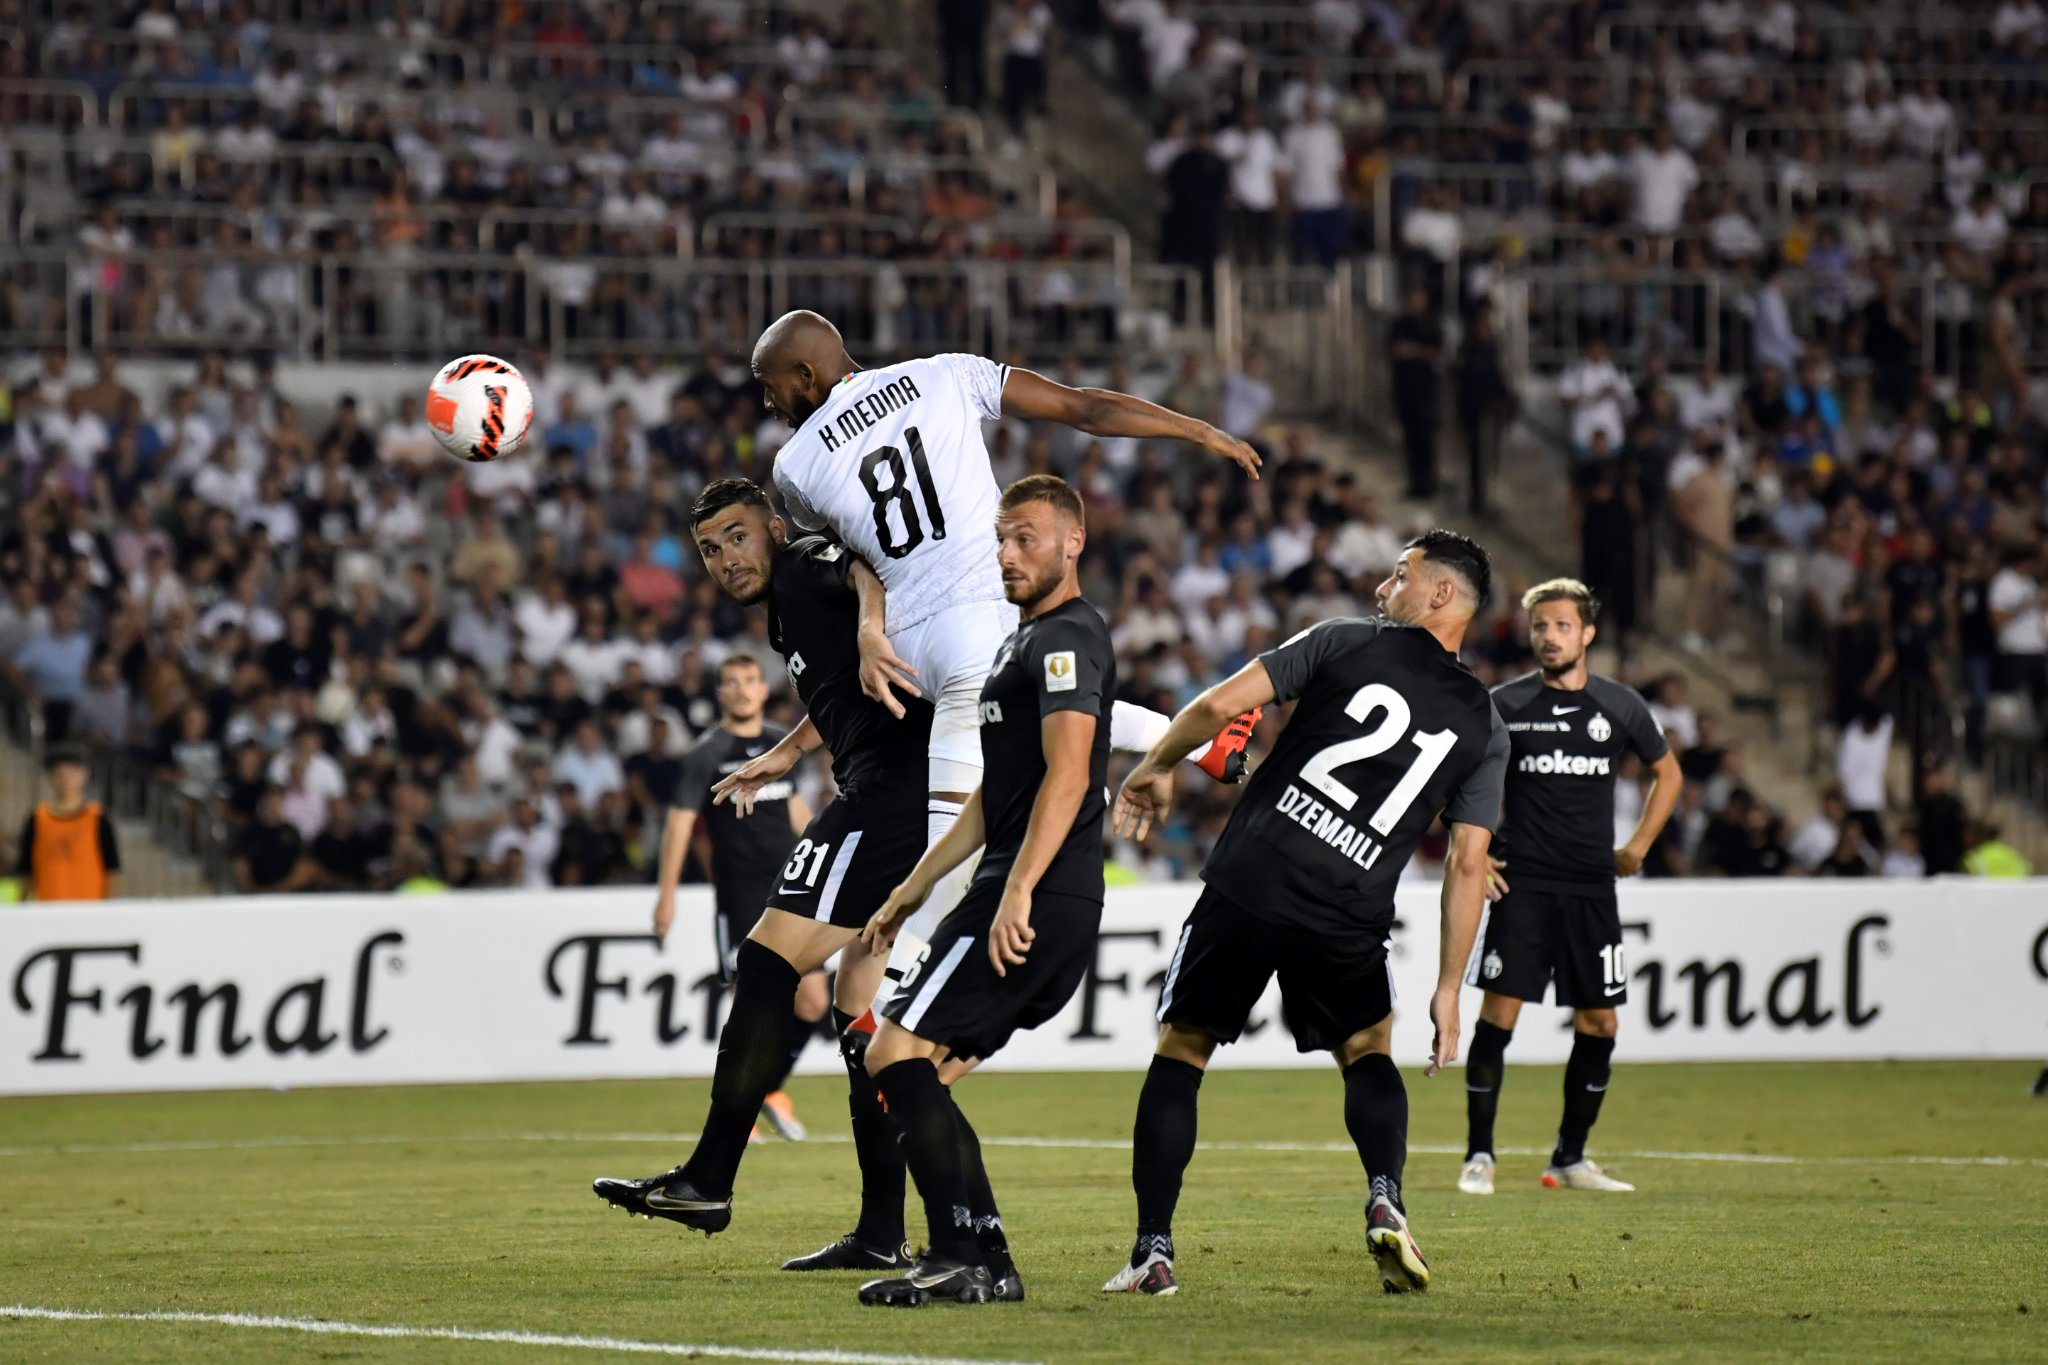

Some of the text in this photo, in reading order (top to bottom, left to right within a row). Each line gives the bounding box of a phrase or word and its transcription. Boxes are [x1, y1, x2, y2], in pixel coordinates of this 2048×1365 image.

[818, 376, 921, 453] K.MEDINA
[858, 426, 947, 560] 81
[1298, 683, 1459, 838] 21
[784, 838, 830, 888] 31
[1275, 784, 1383, 871] DZEMAILI
[13, 930, 404, 1064] Final
[1599, 943, 1627, 985] 10
[1620, 914, 1889, 1032] inal
